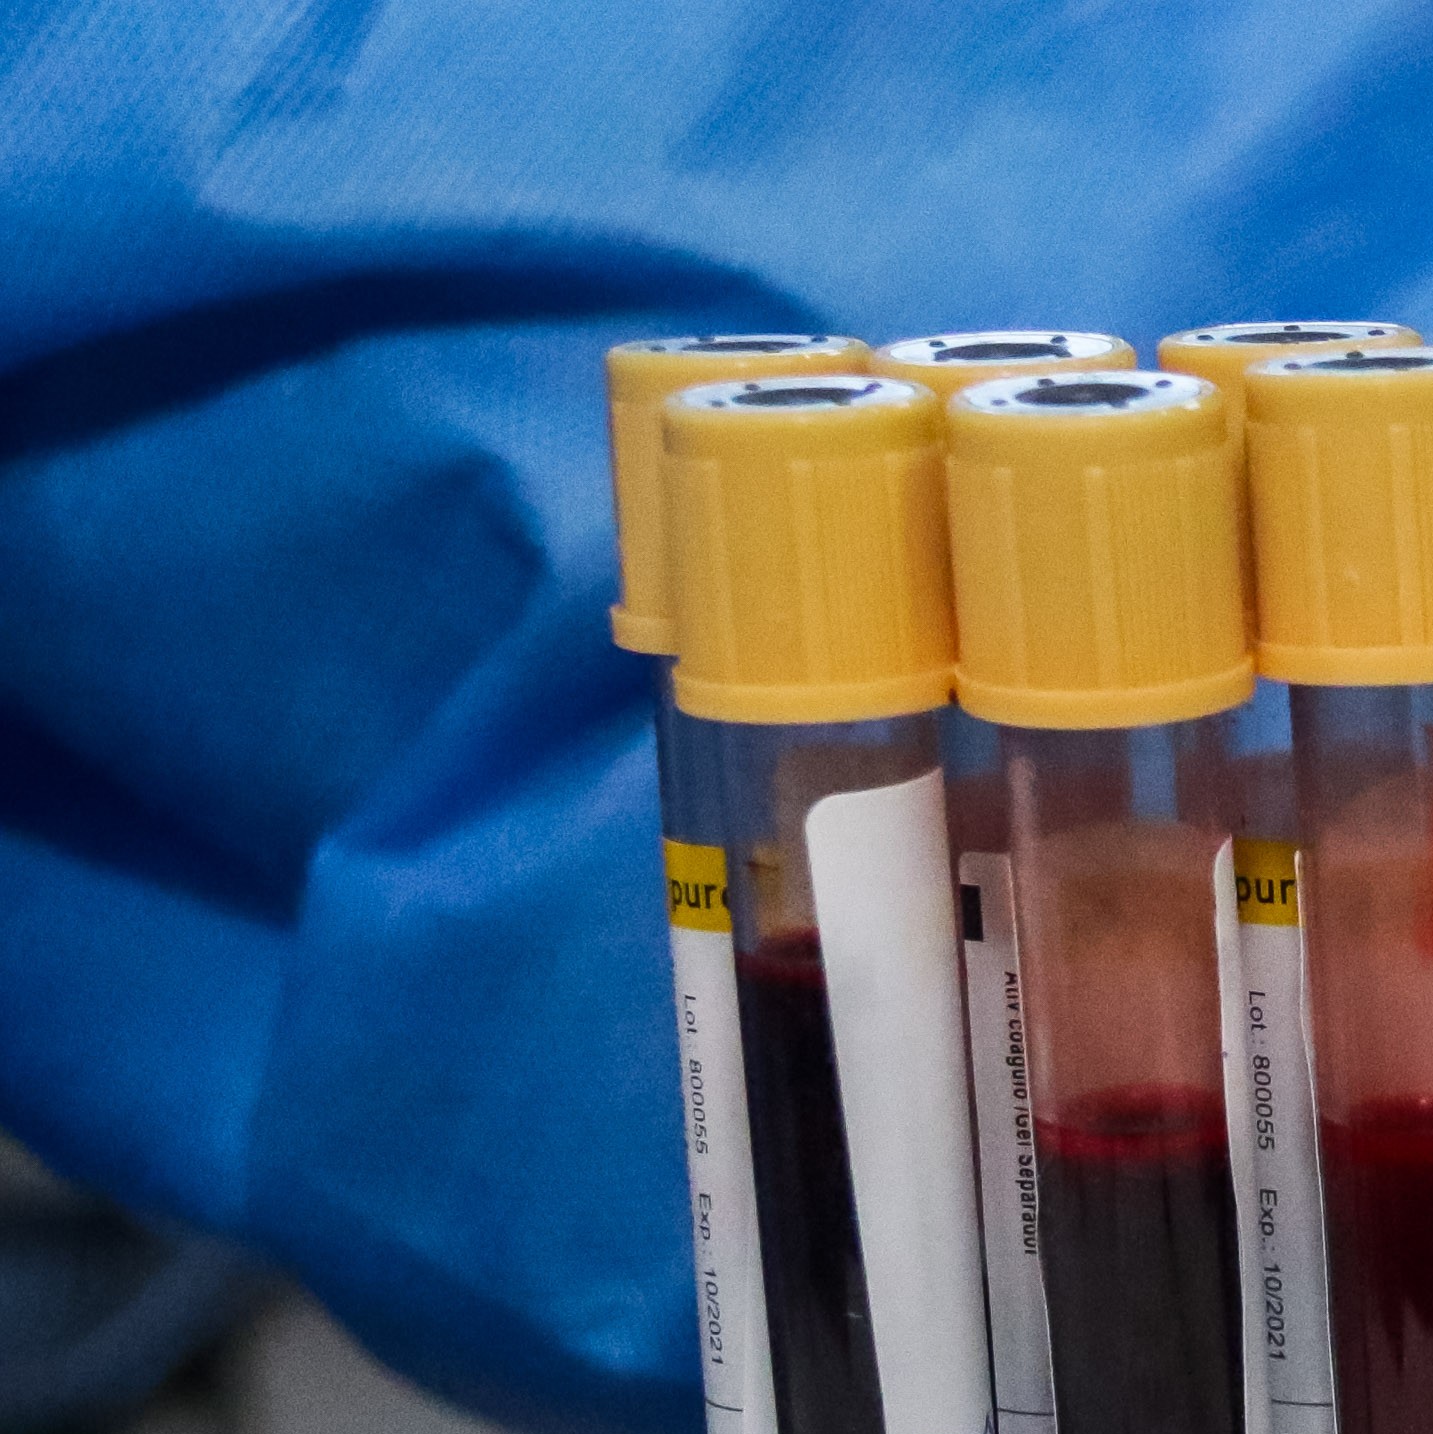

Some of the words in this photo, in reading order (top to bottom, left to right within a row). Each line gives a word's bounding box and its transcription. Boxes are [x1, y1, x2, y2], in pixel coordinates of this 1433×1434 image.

[1252, 1054, 1276, 1151] 800055
[688, 1058, 709, 1155] 800055
[703, 1267, 725, 1366] 10/2021
[1263, 1263, 1287, 1361] 10/2021
